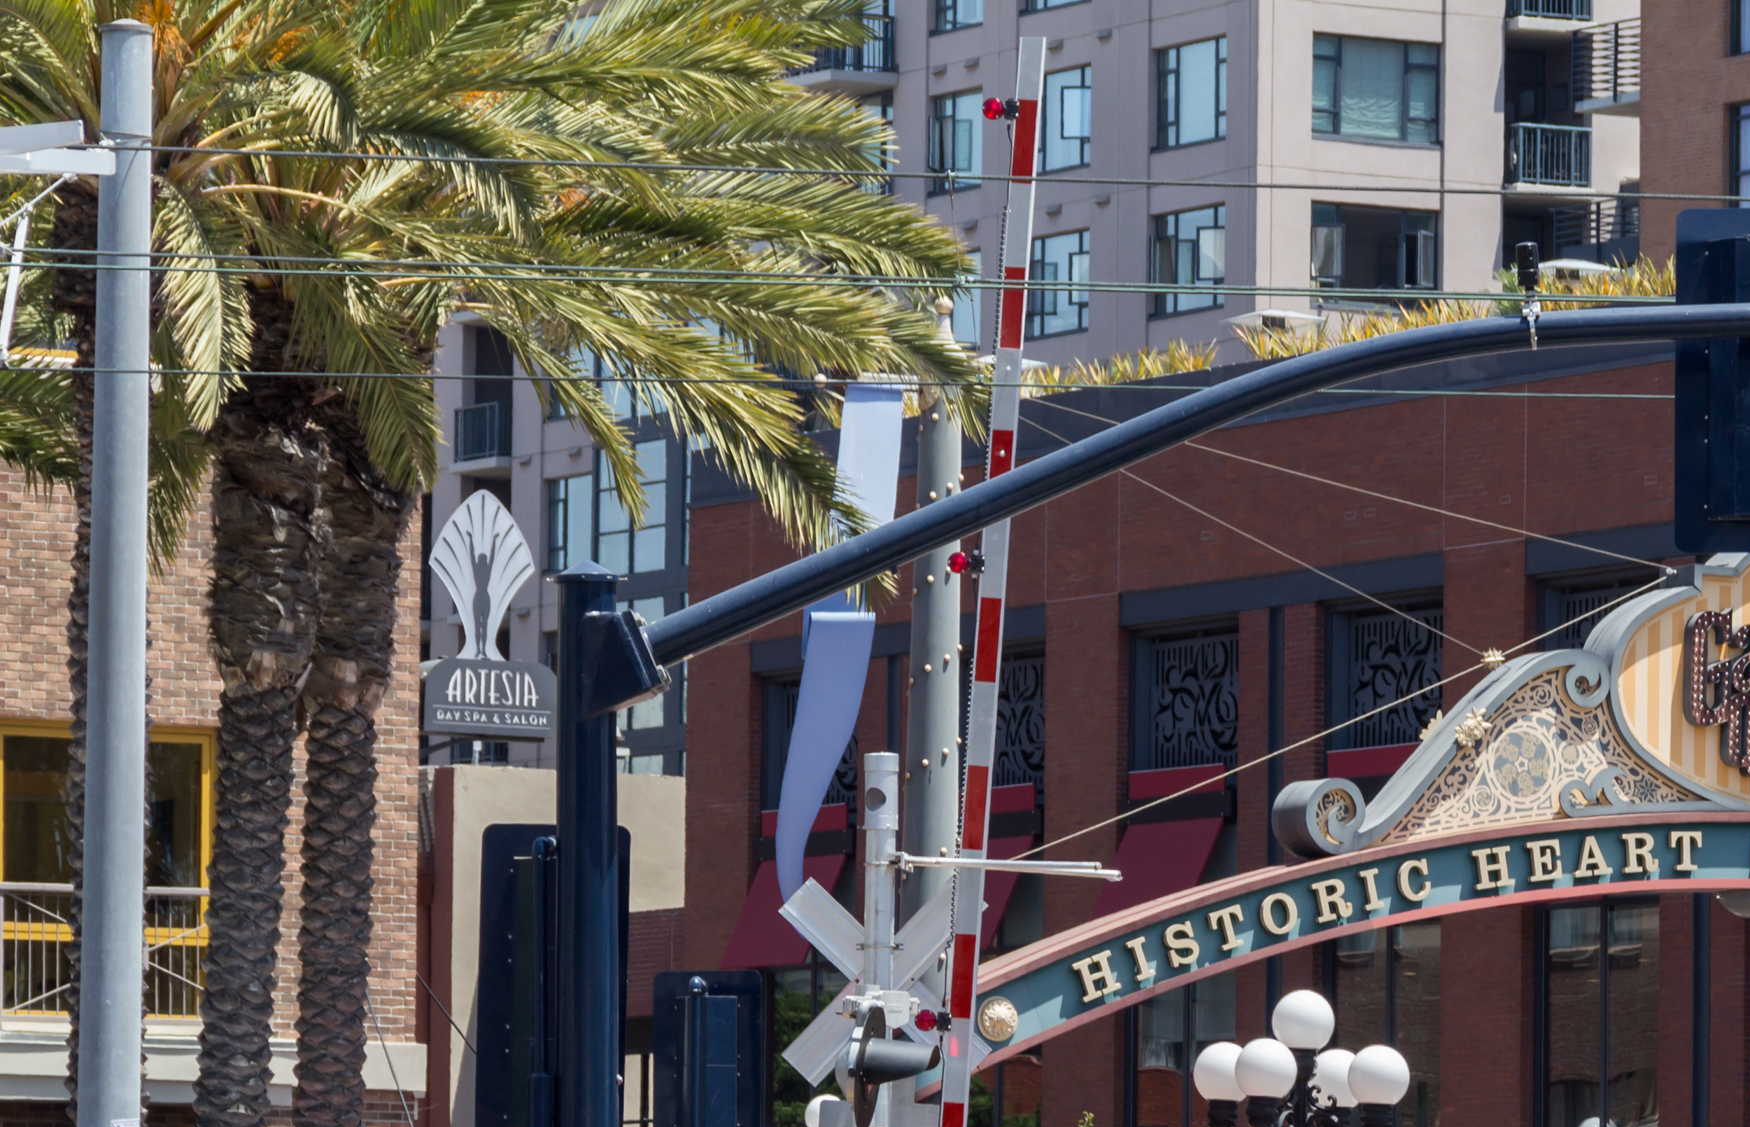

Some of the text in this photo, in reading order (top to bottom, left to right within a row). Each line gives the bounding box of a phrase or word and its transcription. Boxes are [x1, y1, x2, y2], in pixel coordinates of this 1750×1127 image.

[445, 667, 539, 707] ARTESIA
[437, 709, 547, 725] DAY SPA & SALON
[1071, 858, 1431, 1004] HISTORIC
[1472, 830, 1702, 891] HEART
